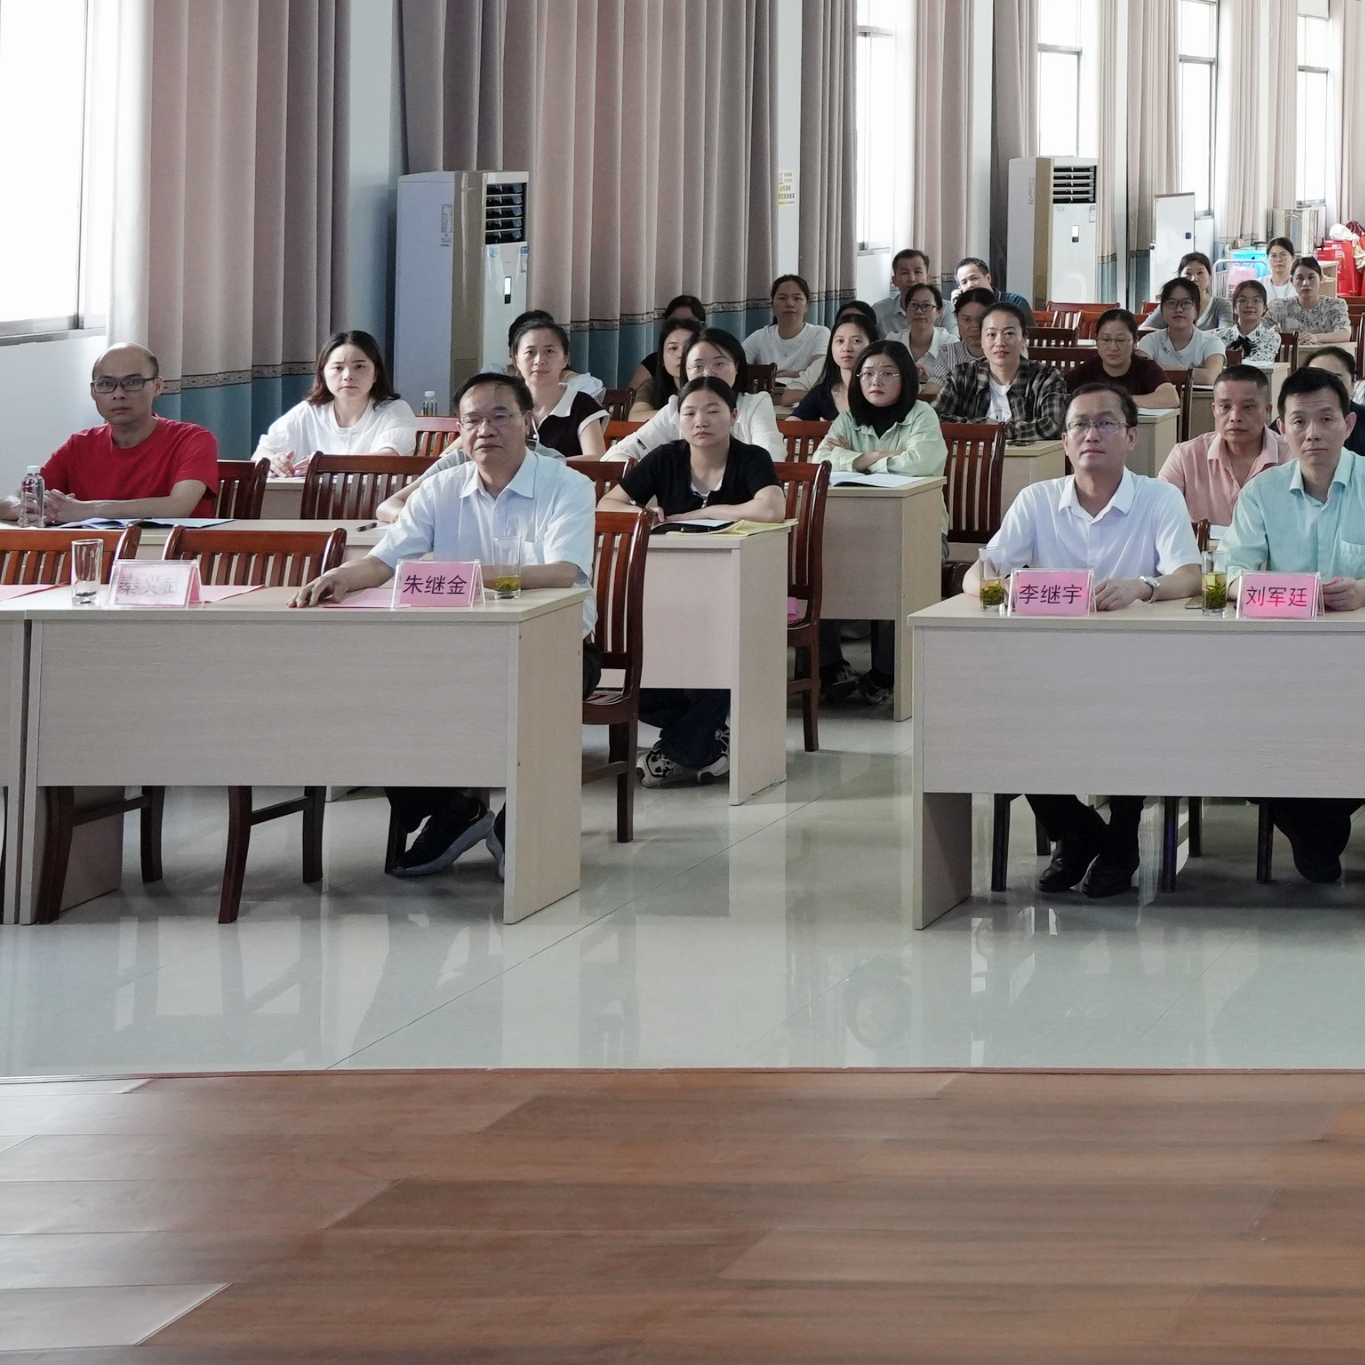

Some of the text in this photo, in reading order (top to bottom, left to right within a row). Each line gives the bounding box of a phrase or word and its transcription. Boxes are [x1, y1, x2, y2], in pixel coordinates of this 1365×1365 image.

[403, 575, 468, 596] 朱继金
[1019, 584, 1083, 605] 李继宇
[1246, 586, 1308, 608] 刘军廷
